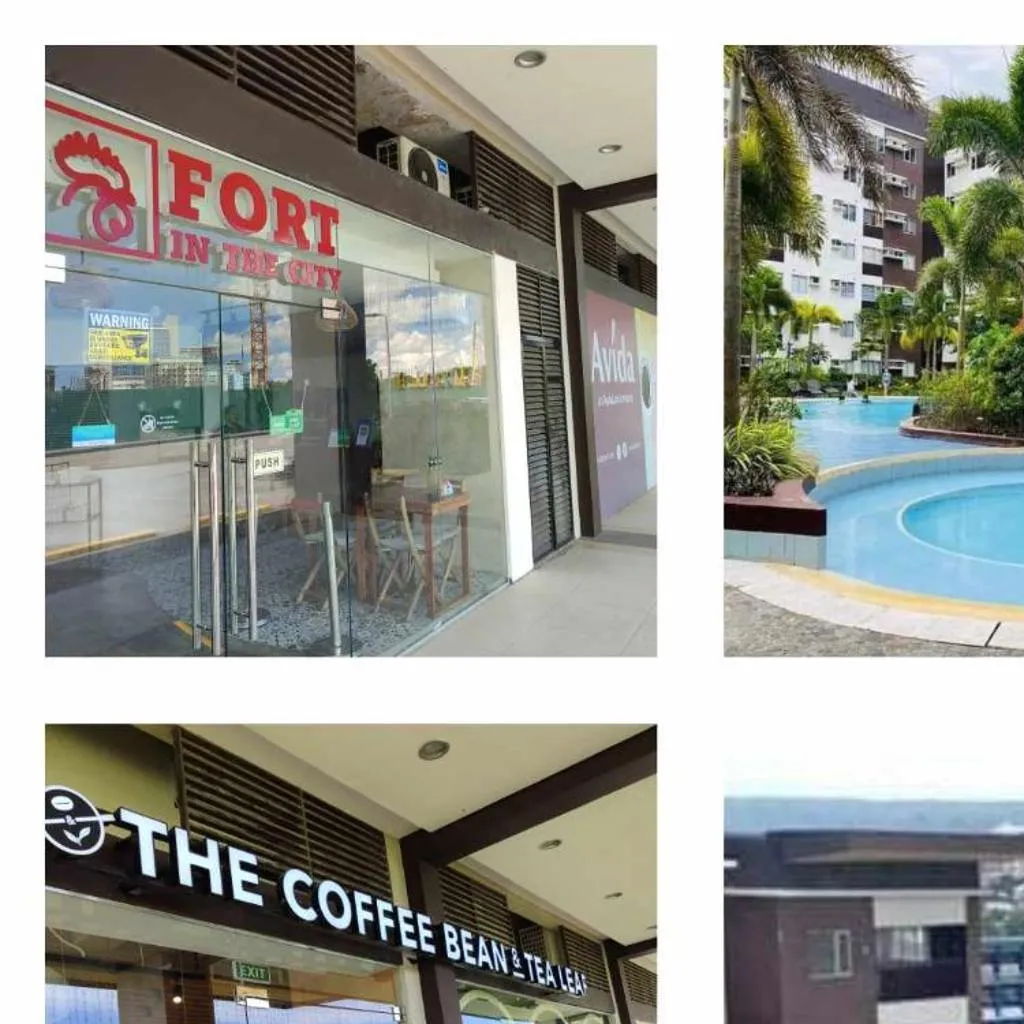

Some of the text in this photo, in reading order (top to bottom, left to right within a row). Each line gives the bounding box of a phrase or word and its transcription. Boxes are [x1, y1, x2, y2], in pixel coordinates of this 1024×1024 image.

[168, 149, 339, 257] FORT
[169, 228, 342, 292] IN THE CITY
[89, 312, 150, 330] WARNING
[591, 317, 636, 383] Avida
[254, 456, 280, 470] PUSH
[119, 807, 264, 907] THE
[282, 868, 436, 955] COFFEE
[443, 921, 508, 975] BEAN
[512, 947, 525, 980] &
[524, 952, 558, 988] TEA
[240, 965, 266, 979] EXIT
